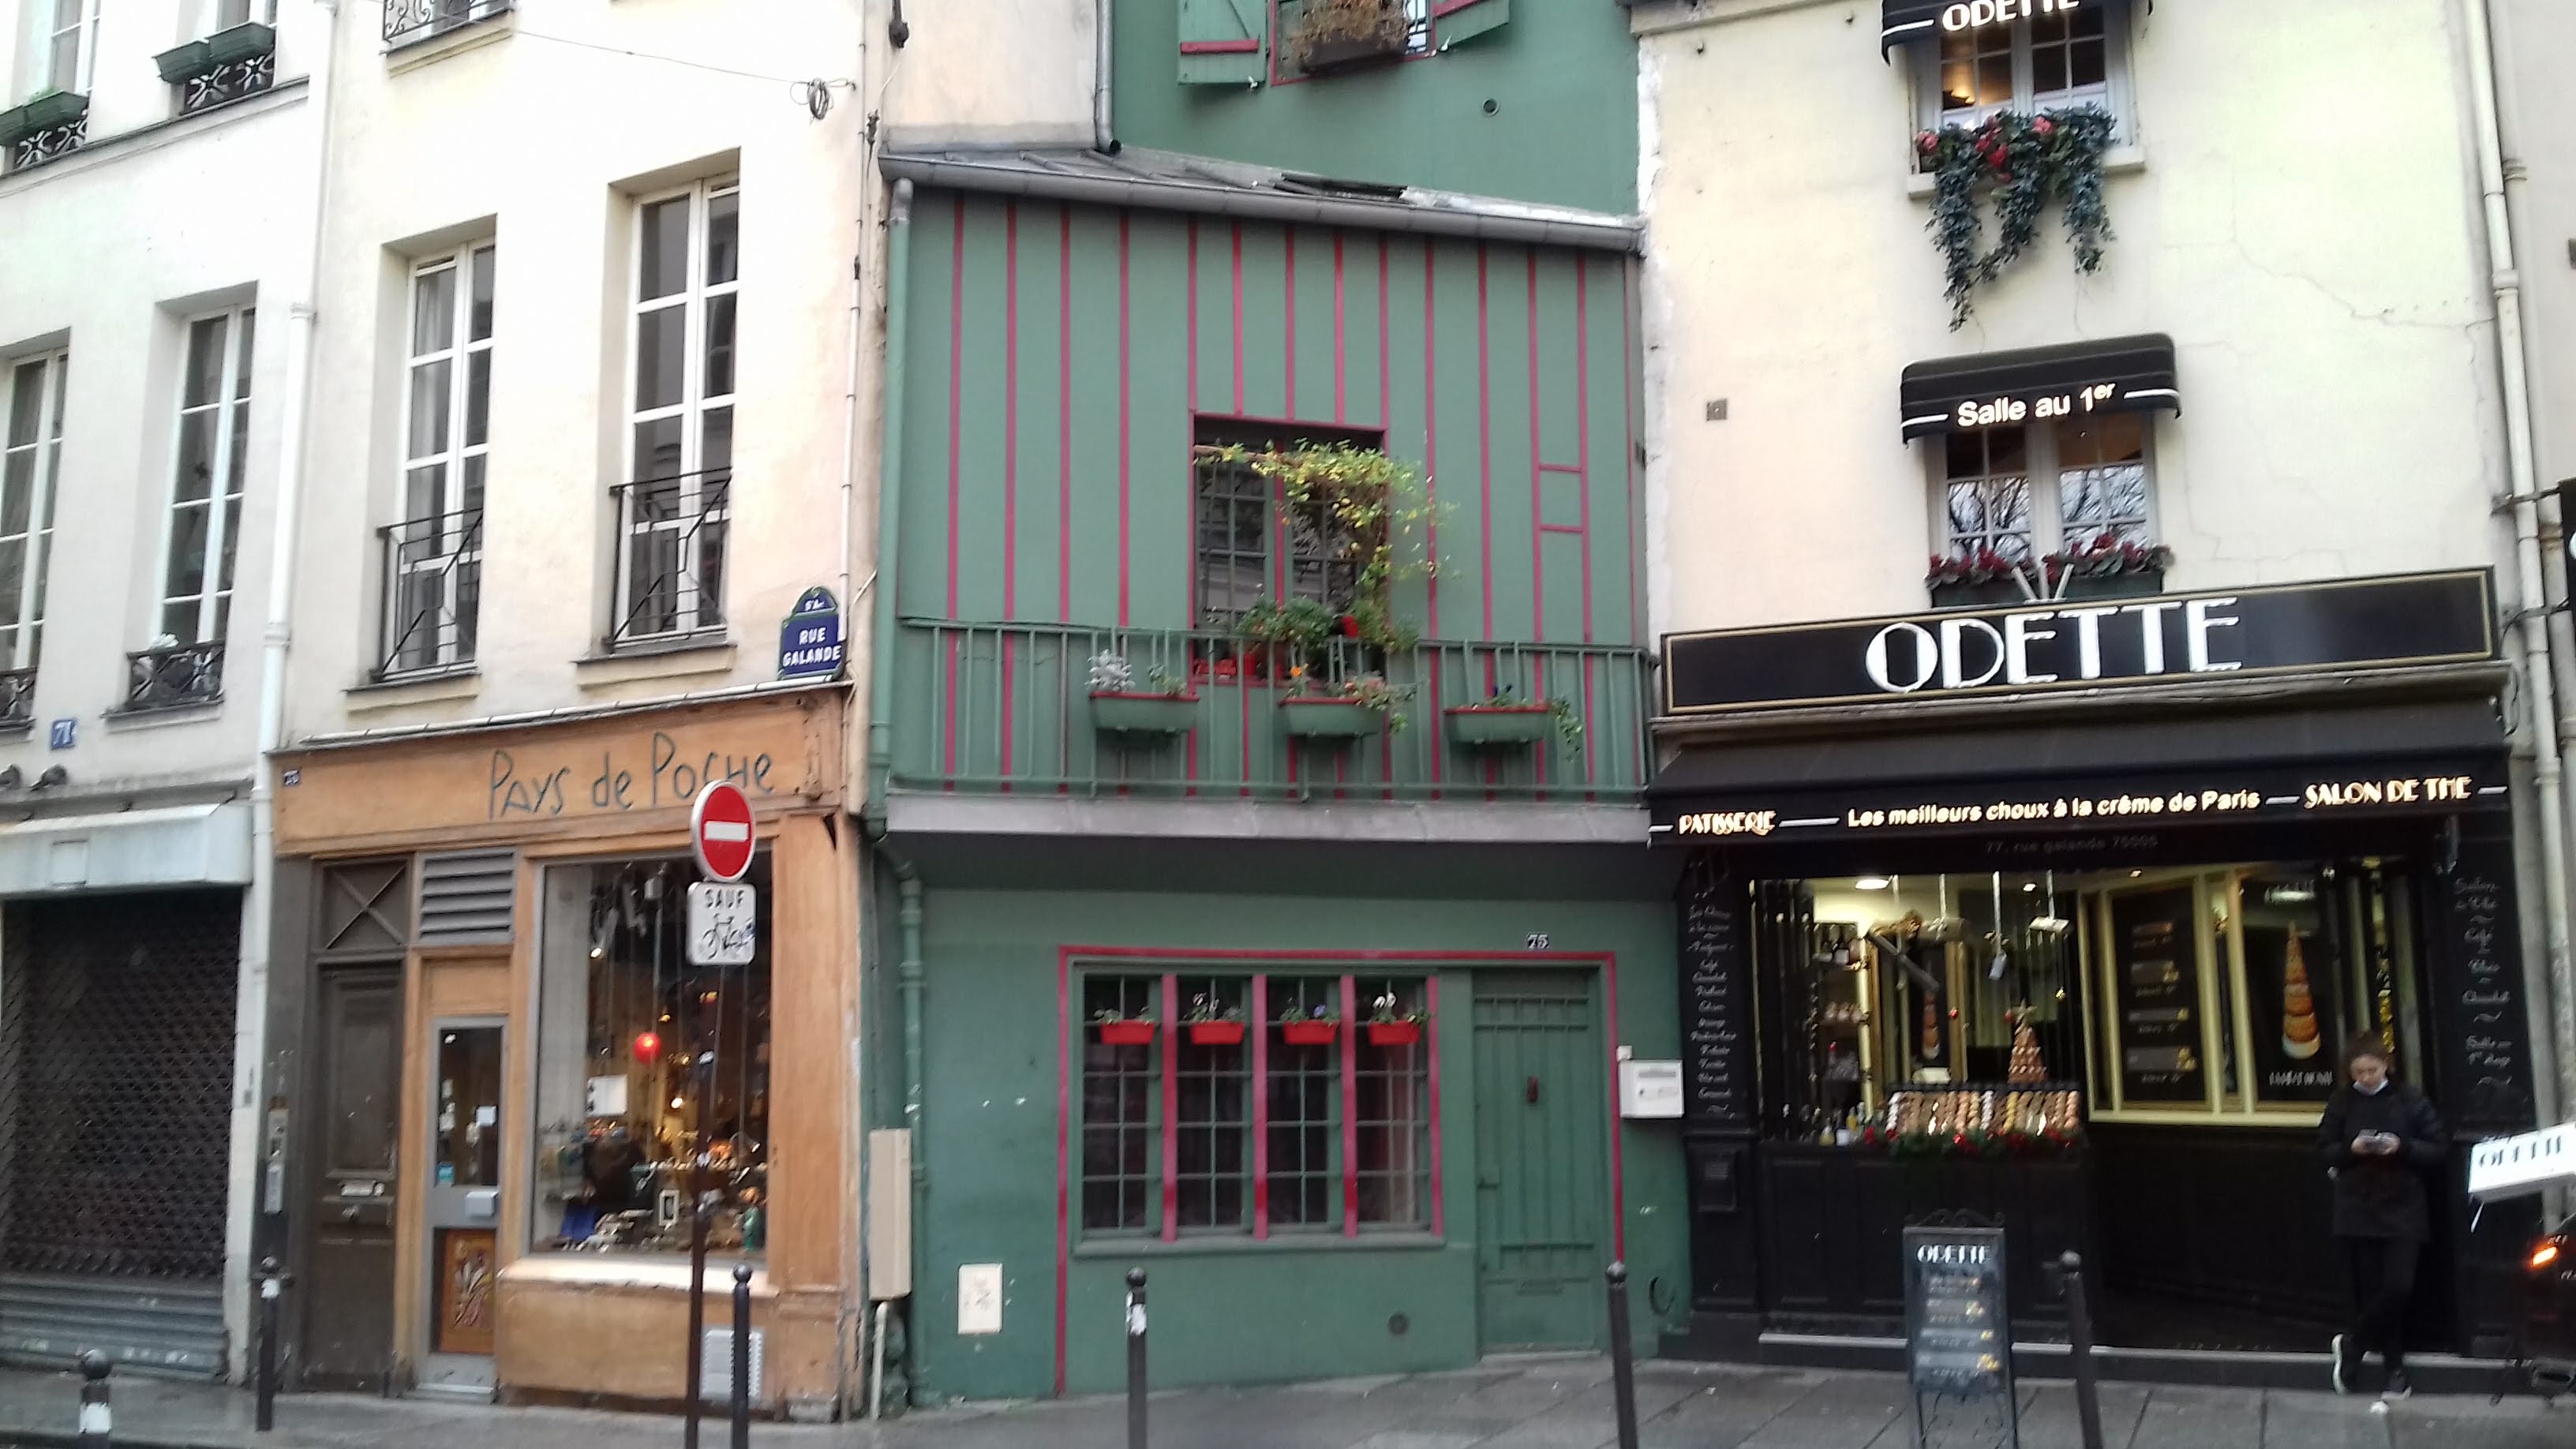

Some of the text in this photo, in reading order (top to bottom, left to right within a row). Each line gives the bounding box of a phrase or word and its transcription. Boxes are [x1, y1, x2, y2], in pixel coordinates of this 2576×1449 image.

[1958, 384, 2116, 427] Salle au 1er
[799, 627, 826, 646] RUE
[1865, 597, 2242, 692] ODETTE
[783, 645, 842, 667] GALANDE
[592, 751, 634, 811] de
[2305, 781, 2383, 809] SALON
[2387, 778, 2421, 803] DE
[1848, 808, 1885, 828] Les
[1889, 803, 1982, 826] meilleurs
[1986, 801, 2050, 821] choux
[2053, 797, 2068, 818] à
[2072, 797, 2092, 817] la
[2169, 791, 2198, 812] de
[2202, 788, 2261, 811] Paris
[1679, 810, 1777, 837] PATISSERIE
[2013, 840, 2040, 853] rue
[706, 889, 744, 909] SAUF
[1528, 934, 1548, 949] 75
